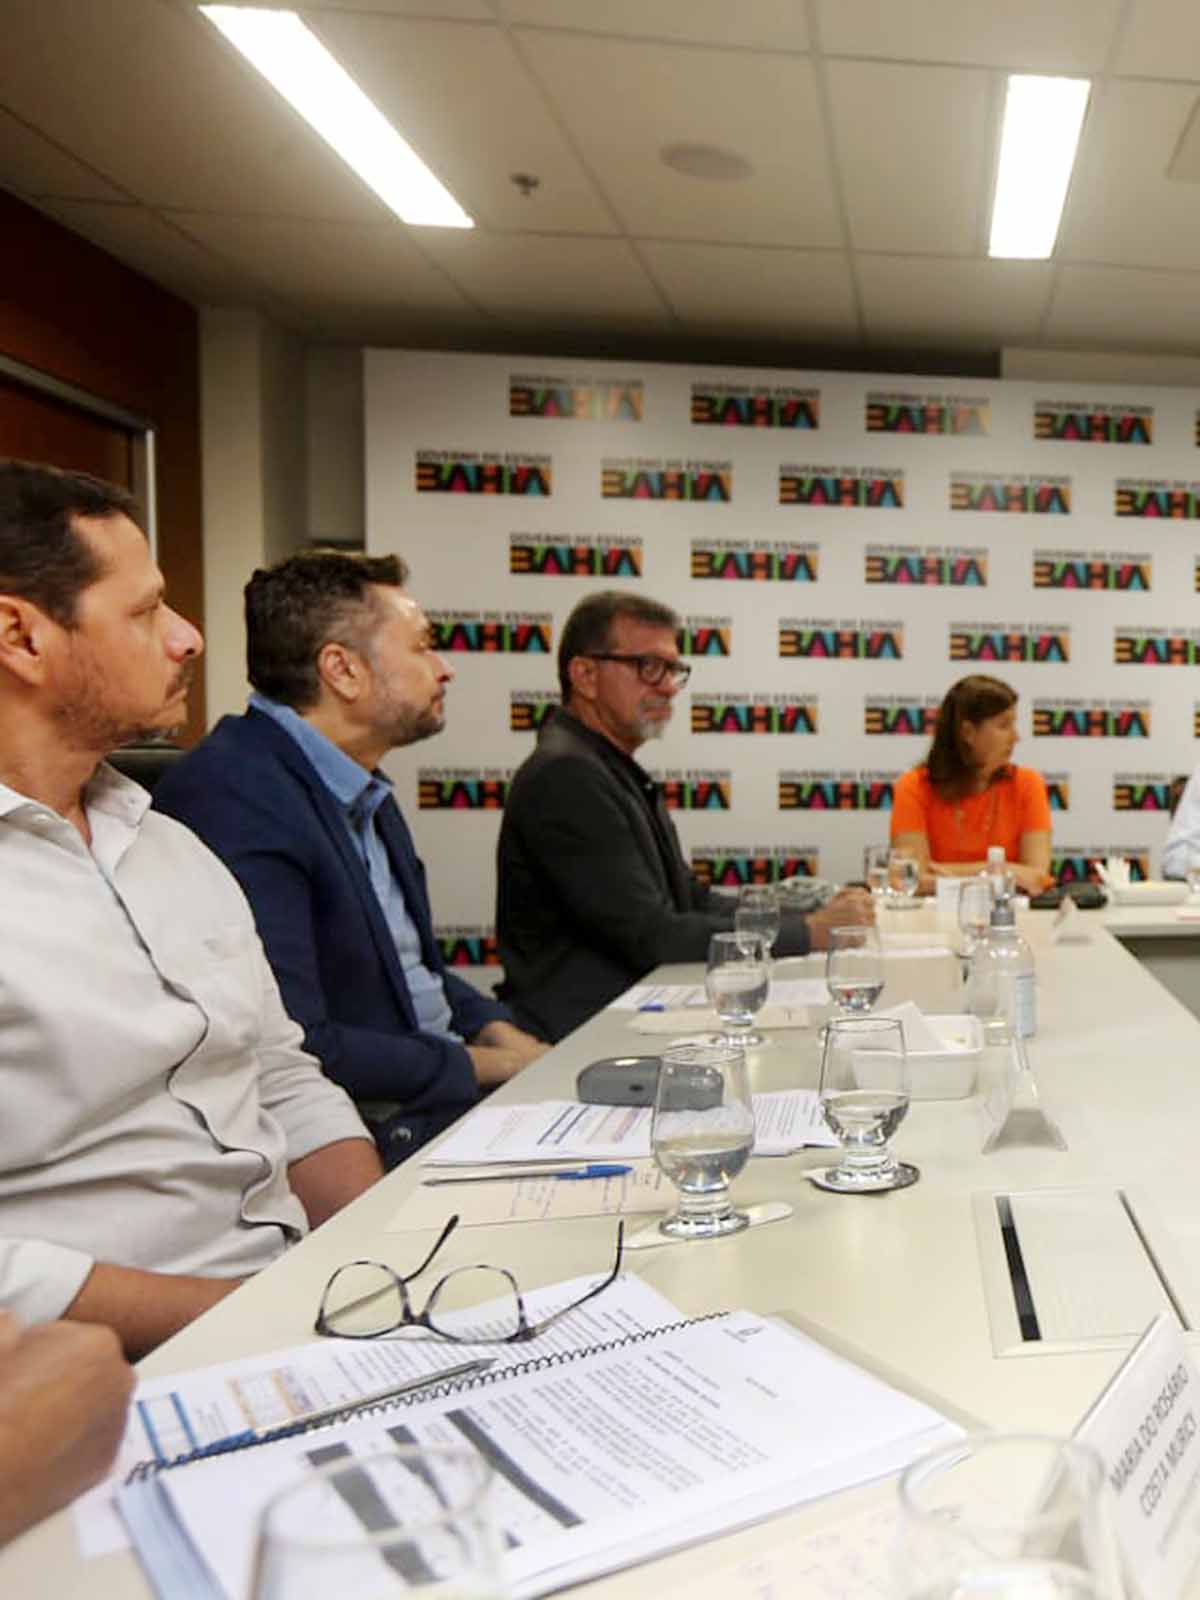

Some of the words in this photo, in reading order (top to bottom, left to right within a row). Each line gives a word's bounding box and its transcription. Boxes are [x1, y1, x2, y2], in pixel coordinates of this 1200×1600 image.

[692, 396, 818, 429] BAHIA
[1035, 414, 1152, 444] BAHIA
[416, 463, 552, 495] BAHIA
[602, 472, 733, 501] BAHIA
[780, 478, 905, 507] BAHIA
[950, 484, 1073, 513] BAHIA
[510, 546, 643, 576] BAHIA
[692, 552, 818, 580] BAHIA
[866, 557, 988, 585] BAHIA
[1035, 562, 1152, 590] BAHIA
[780, 631, 904, 659] BAHIA
[949, 635, 1072, 662] BAHIA
[692, 705, 817, 733] BAHIA
[1034, 710, 1151, 737] BAHIA
